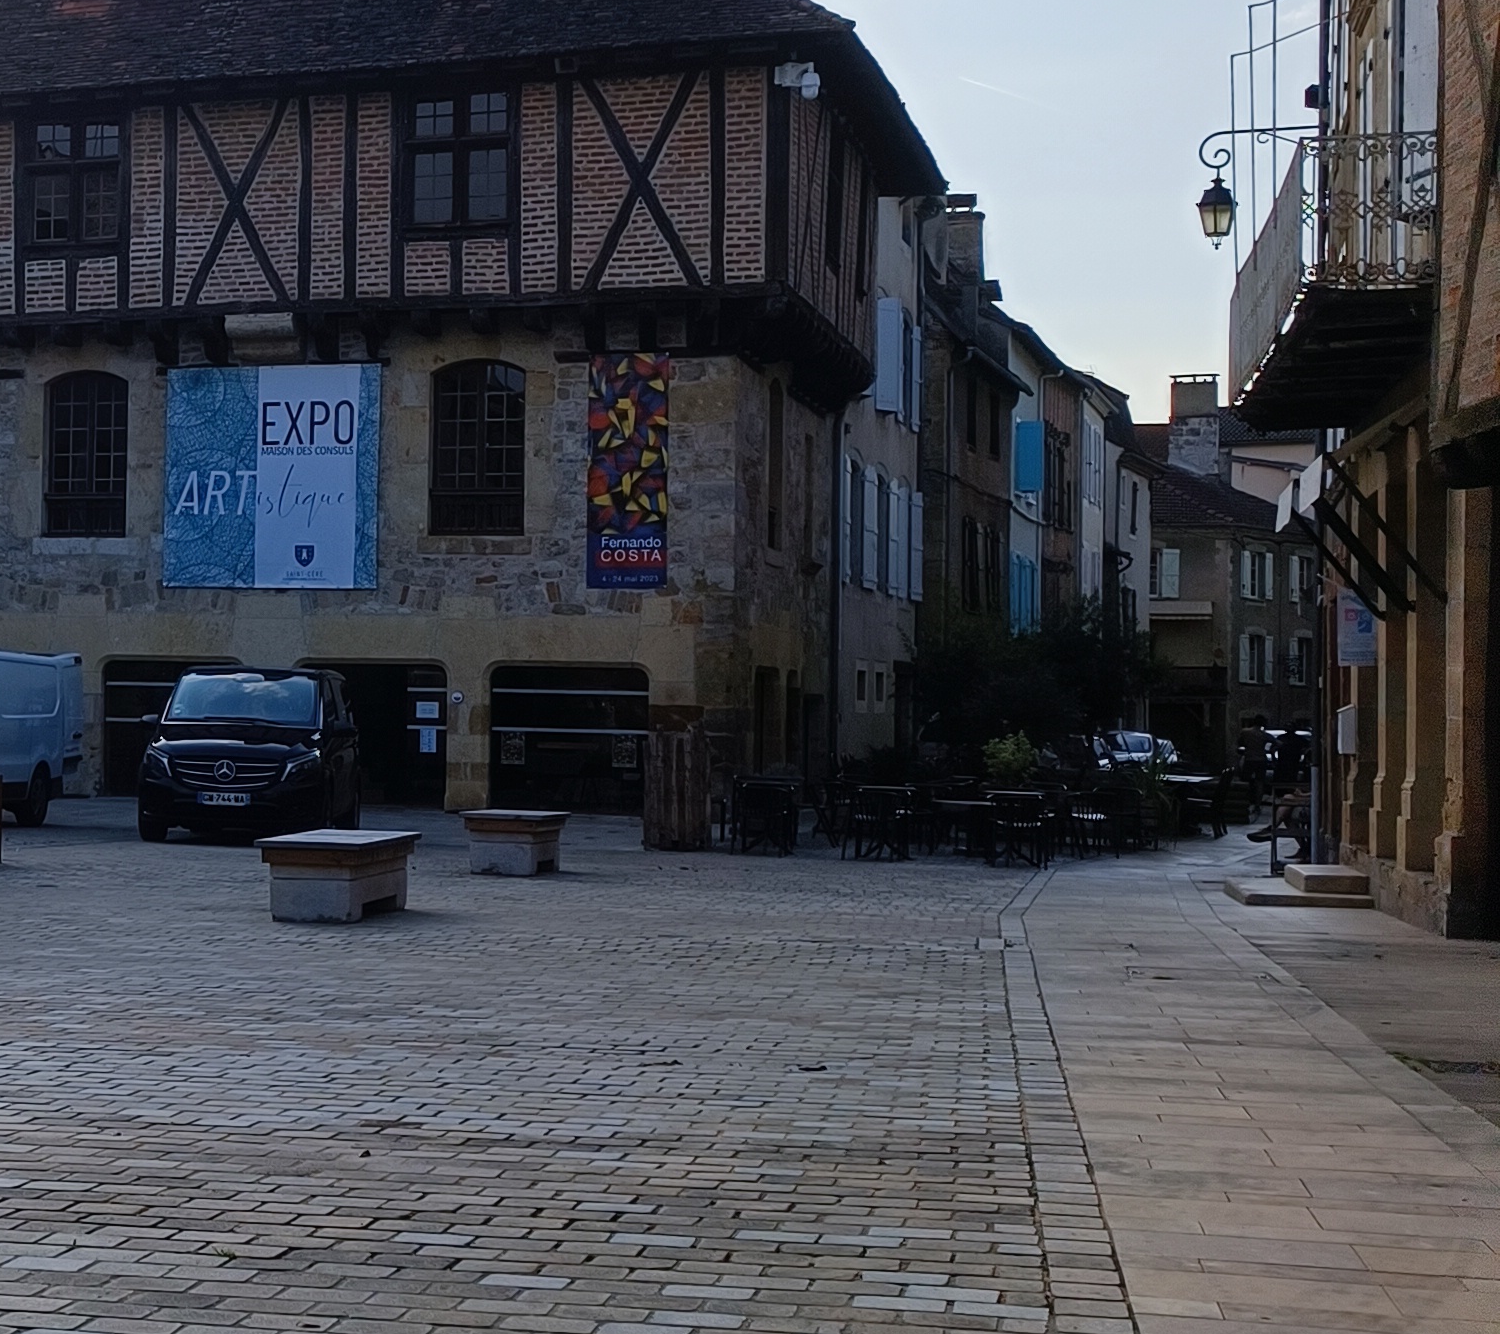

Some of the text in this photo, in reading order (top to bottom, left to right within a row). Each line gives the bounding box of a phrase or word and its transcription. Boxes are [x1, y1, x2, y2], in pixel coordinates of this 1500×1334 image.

[261, 400, 355, 445] EXPO
[261, 445, 354, 456] MAISON DES CONSULS
[601, 536, 662, 548] Fernando
[600, 549, 662, 562] COSTA
